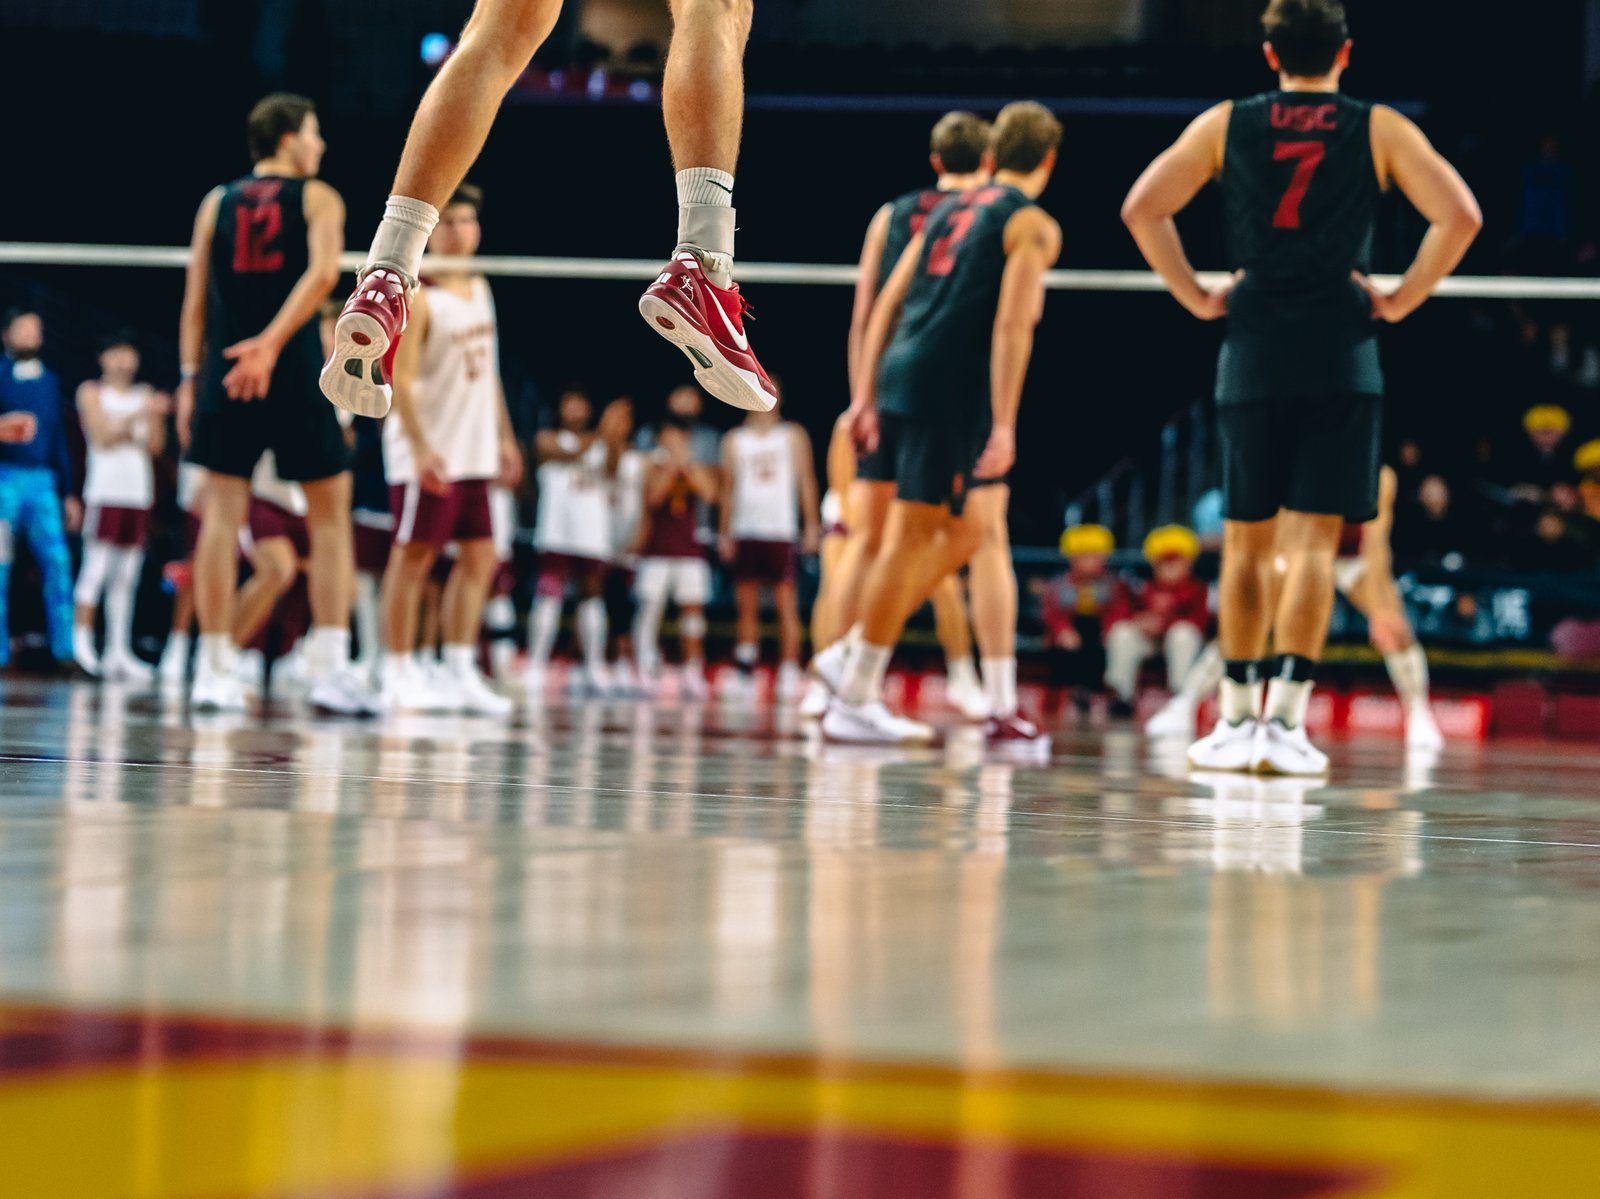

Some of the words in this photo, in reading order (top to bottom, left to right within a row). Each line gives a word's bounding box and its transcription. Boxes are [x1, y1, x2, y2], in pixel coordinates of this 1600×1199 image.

[1270, 103, 1337, 132] USC
[1272, 141, 1325, 228] 7
[233, 202, 284, 272] 12
